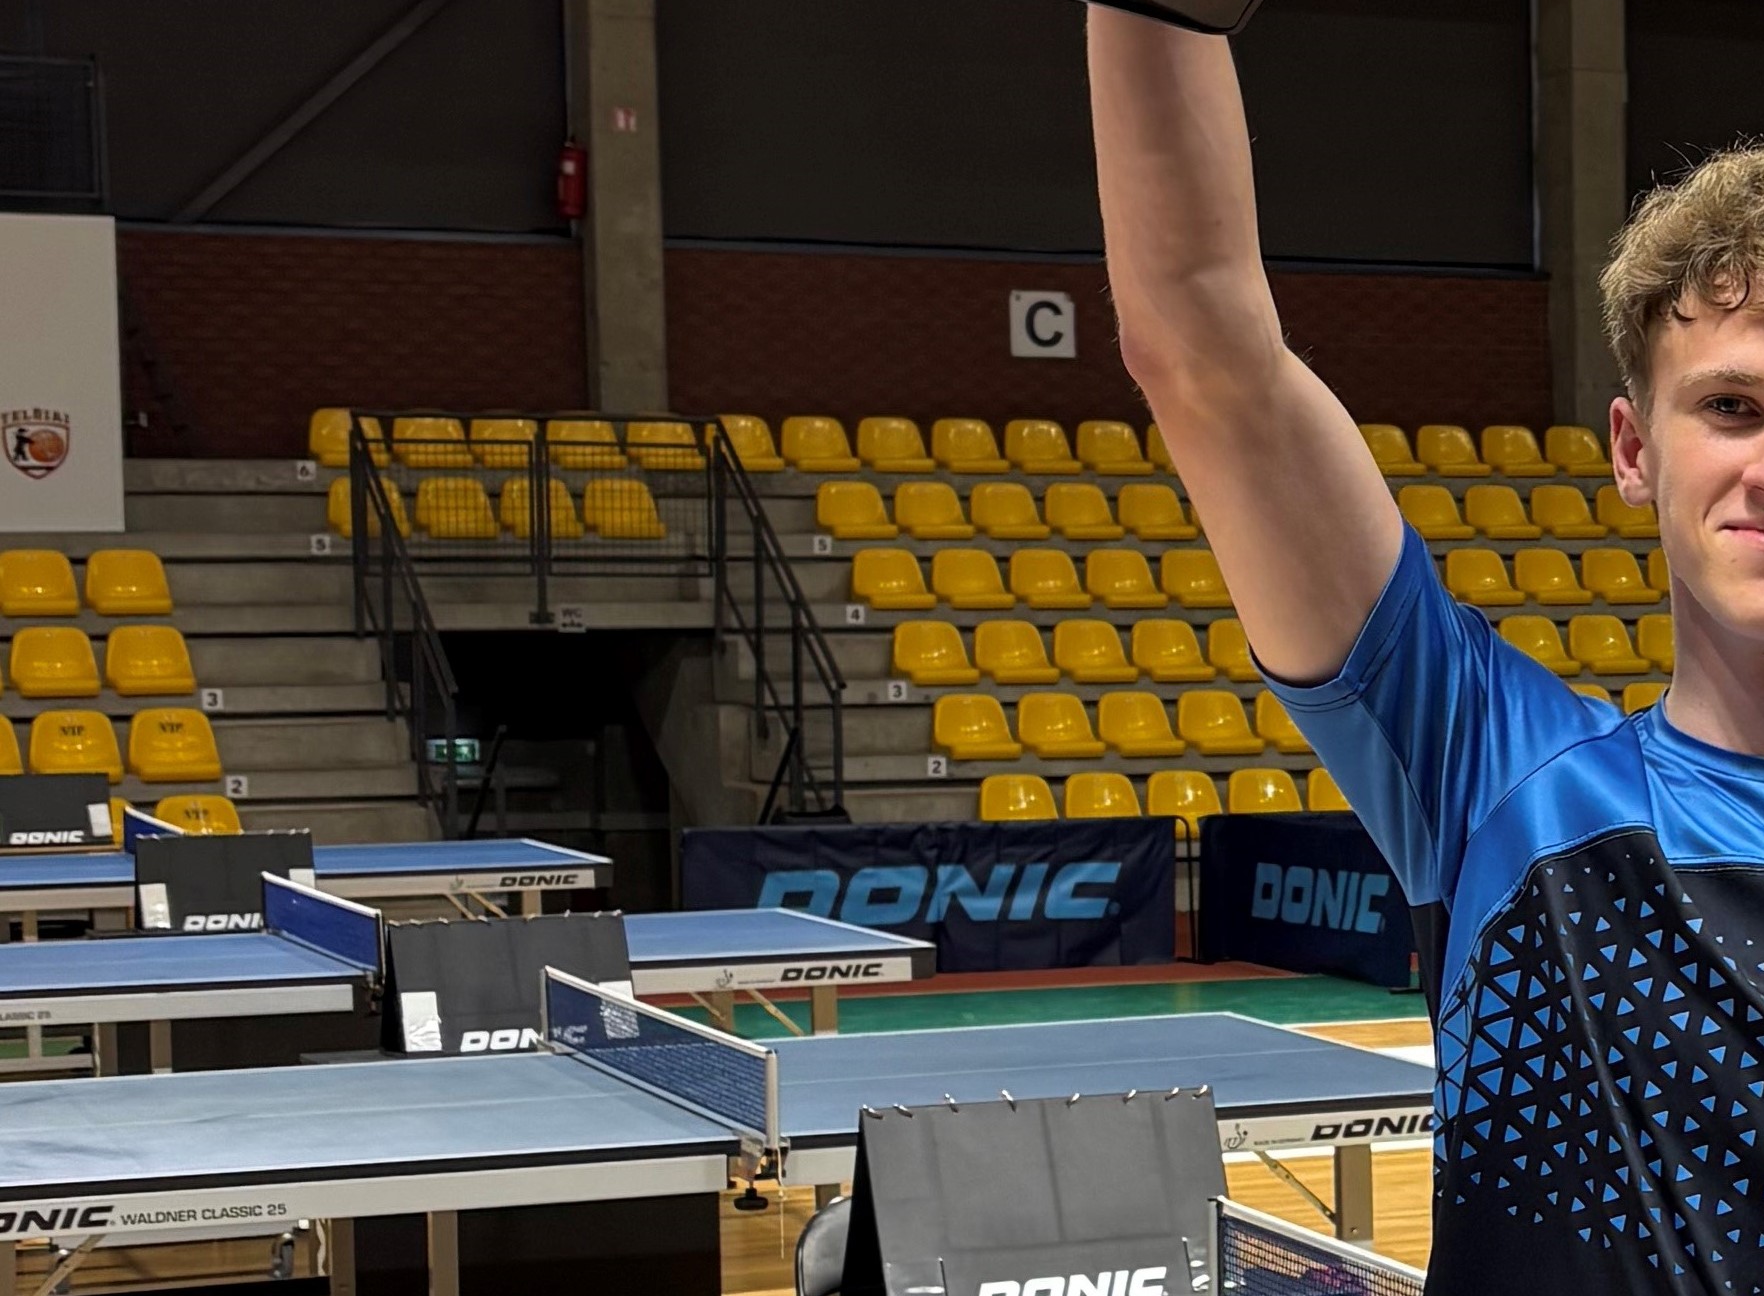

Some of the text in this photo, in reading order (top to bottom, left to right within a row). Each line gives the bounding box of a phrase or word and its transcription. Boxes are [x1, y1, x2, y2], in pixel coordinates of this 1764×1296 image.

[1025, 301, 1063, 347] C
[817, 538, 827, 551] 5
[850, 608, 860, 621] 4
[891, 684, 902, 698] 3
[207, 692, 218, 707] 3
[59, 725, 86, 736] VIP
[159, 722, 184, 734] VIP
[931, 760, 942, 773] 2
[231, 779, 242, 793] 2
[10, 830, 84, 845] DONIC
[500, 873, 579, 887] DONIC
[757, 861, 1121, 924] DONIC
[1252, 862, 1391, 934] DONIC
[184, 912, 263, 932] DONI
[780, 962, 884, 982] DONIC
[121, 1210, 197, 1226] WALDNER
[202, 1204, 263, 1221] CLASSIC
[267, 1203, 287, 1216] 25
